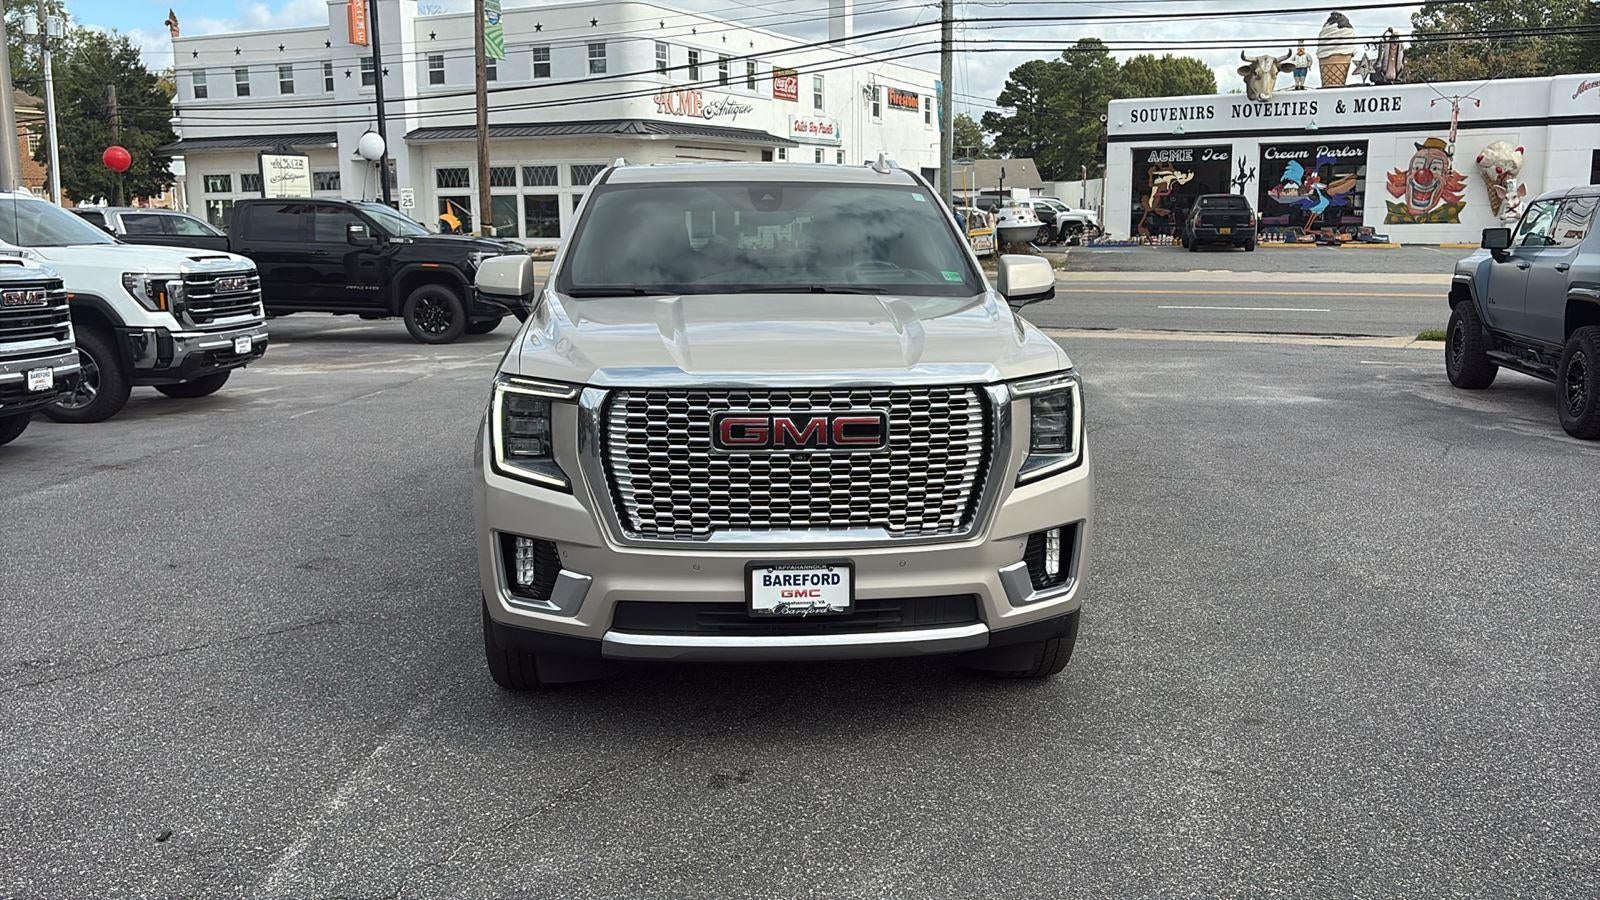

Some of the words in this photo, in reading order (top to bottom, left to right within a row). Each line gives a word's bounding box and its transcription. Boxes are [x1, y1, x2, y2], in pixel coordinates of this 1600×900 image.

[653, 87, 703, 118] ACME
[703, 96, 753, 121] Antiques
[1131, 106, 1215, 123] SOUVENIRS
[1231, 101, 1318, 118] NOVELTIES
[1335, 99, 1346, 114] &
[1353, 97, 1402, 113] MORE
[1148, 149, 1193, 162] ACME
[1202, 148, 1229, 161] Ice
[1264, 147, 1309, 160] Cream
[1315, 145, 1364, 158] Parlor
[402, 199, 414, 207] 25
[219, 278, 248, 291] GMC
[3, 291, 46, 305] GMC
[720, 416, 881, 446] GMC
[763, 573, 841, 587] BAREFORD
[781, 588, 821, 598] GMC
[772, 603, 832, 618] Bareford
